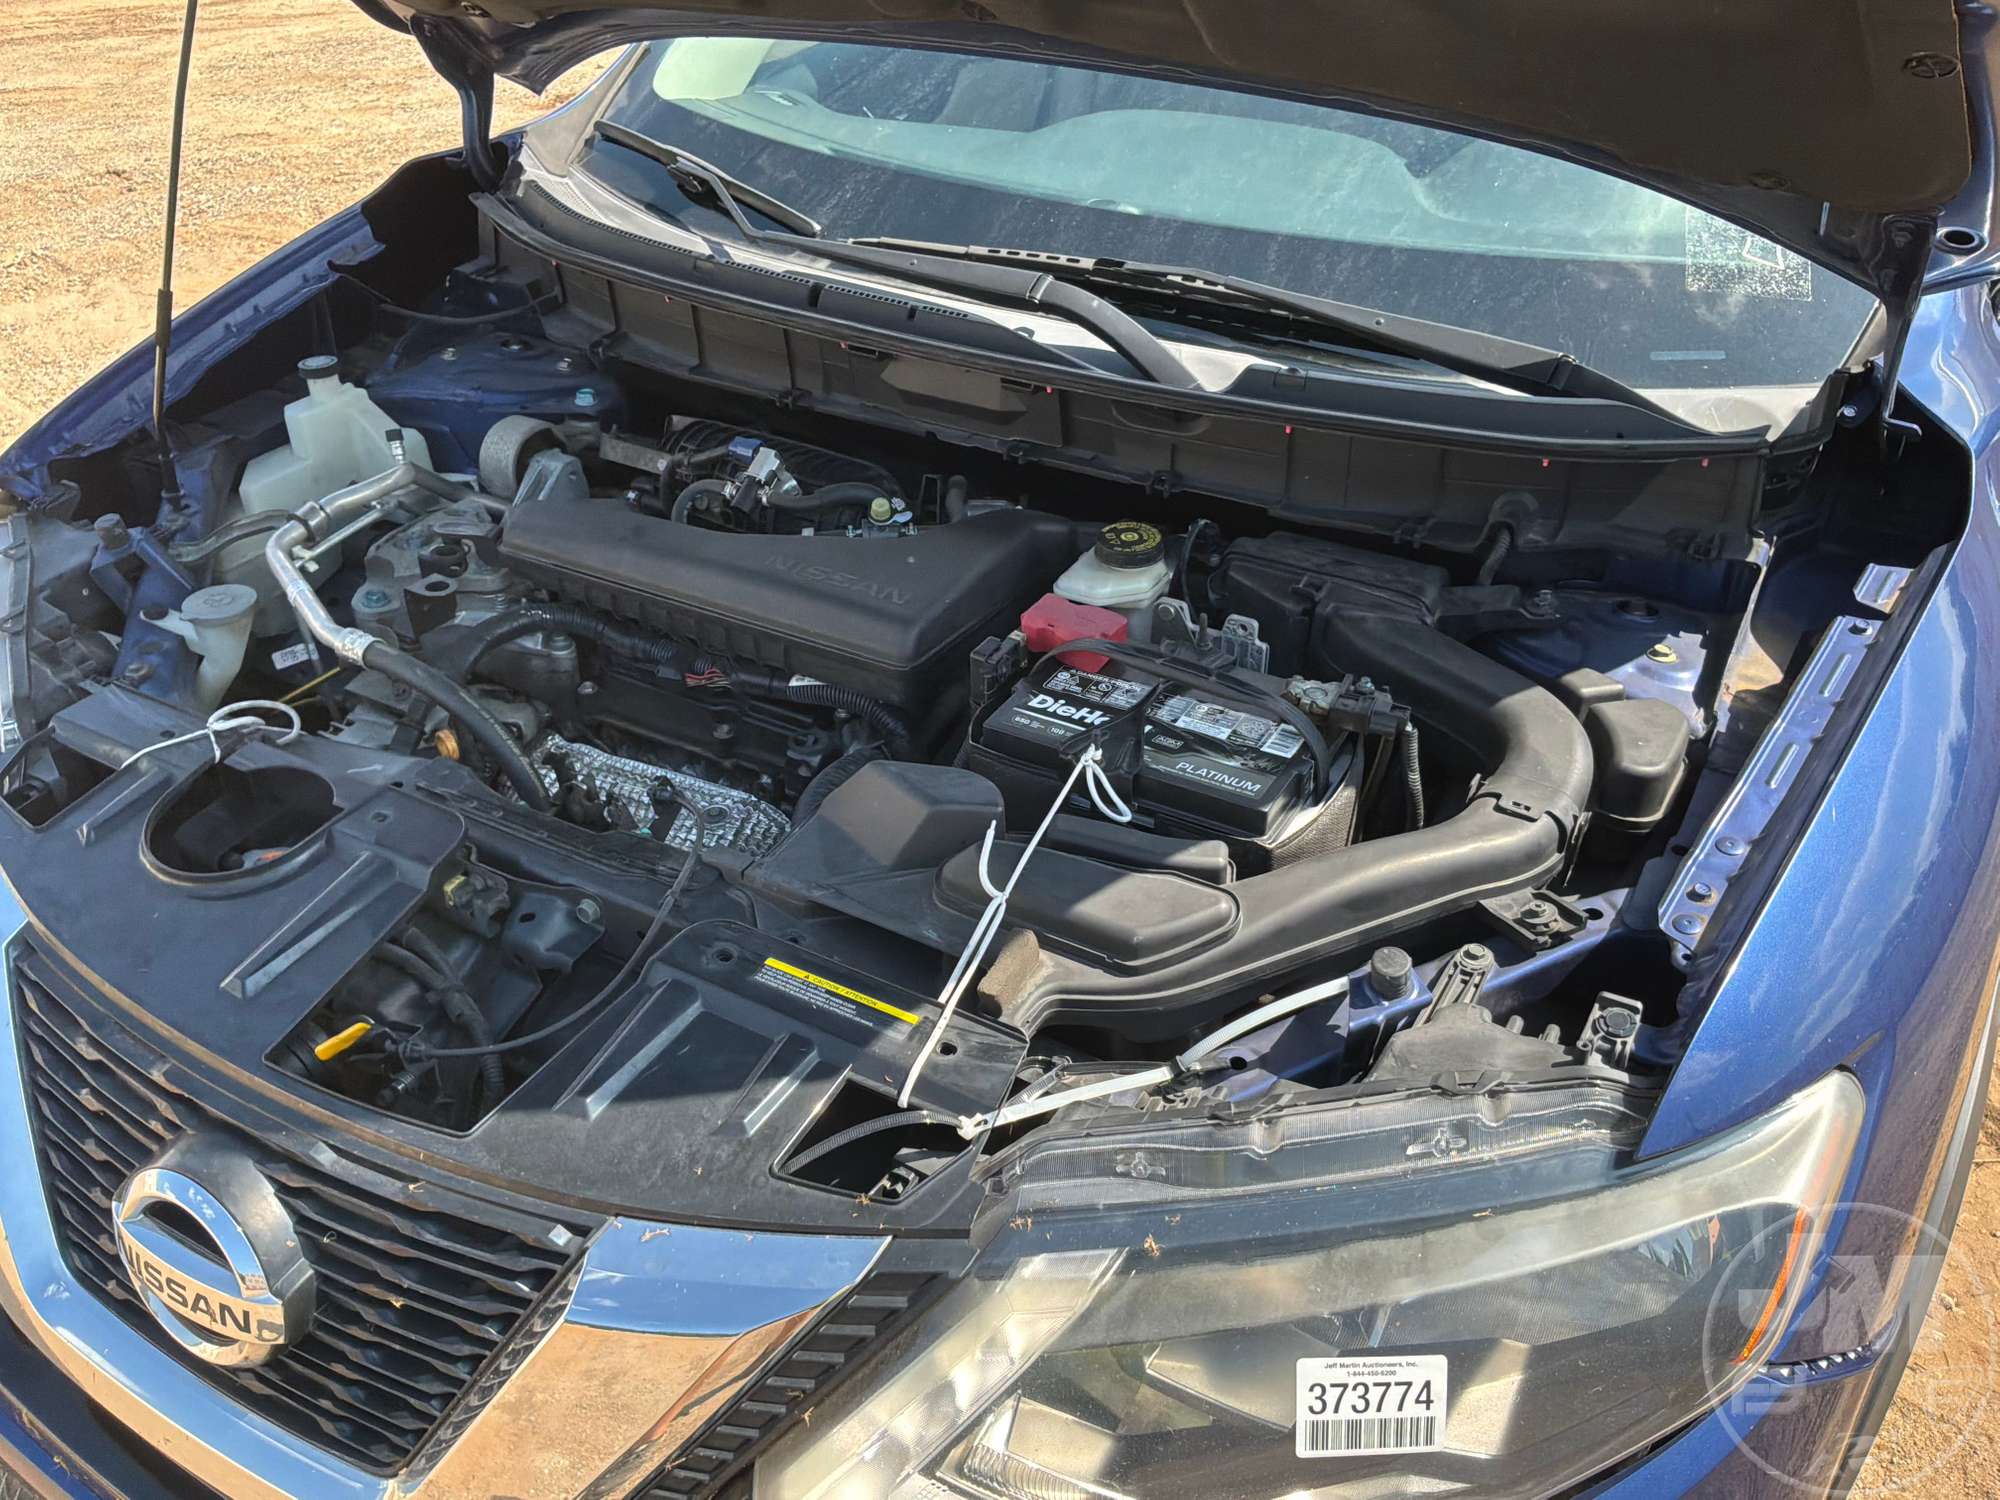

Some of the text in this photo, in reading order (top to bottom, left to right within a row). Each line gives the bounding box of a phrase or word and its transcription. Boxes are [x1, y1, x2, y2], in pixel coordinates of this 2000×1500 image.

[764, 554, 914, 605] NISSAN
[1028, 693, 1112, 726] DieH
[1175, 762, 1262, 793] PLATINUM
[1362, 1361, 1404, 1369] Auctioneers,
[1307, 1379, 1435, 1415] 373774
